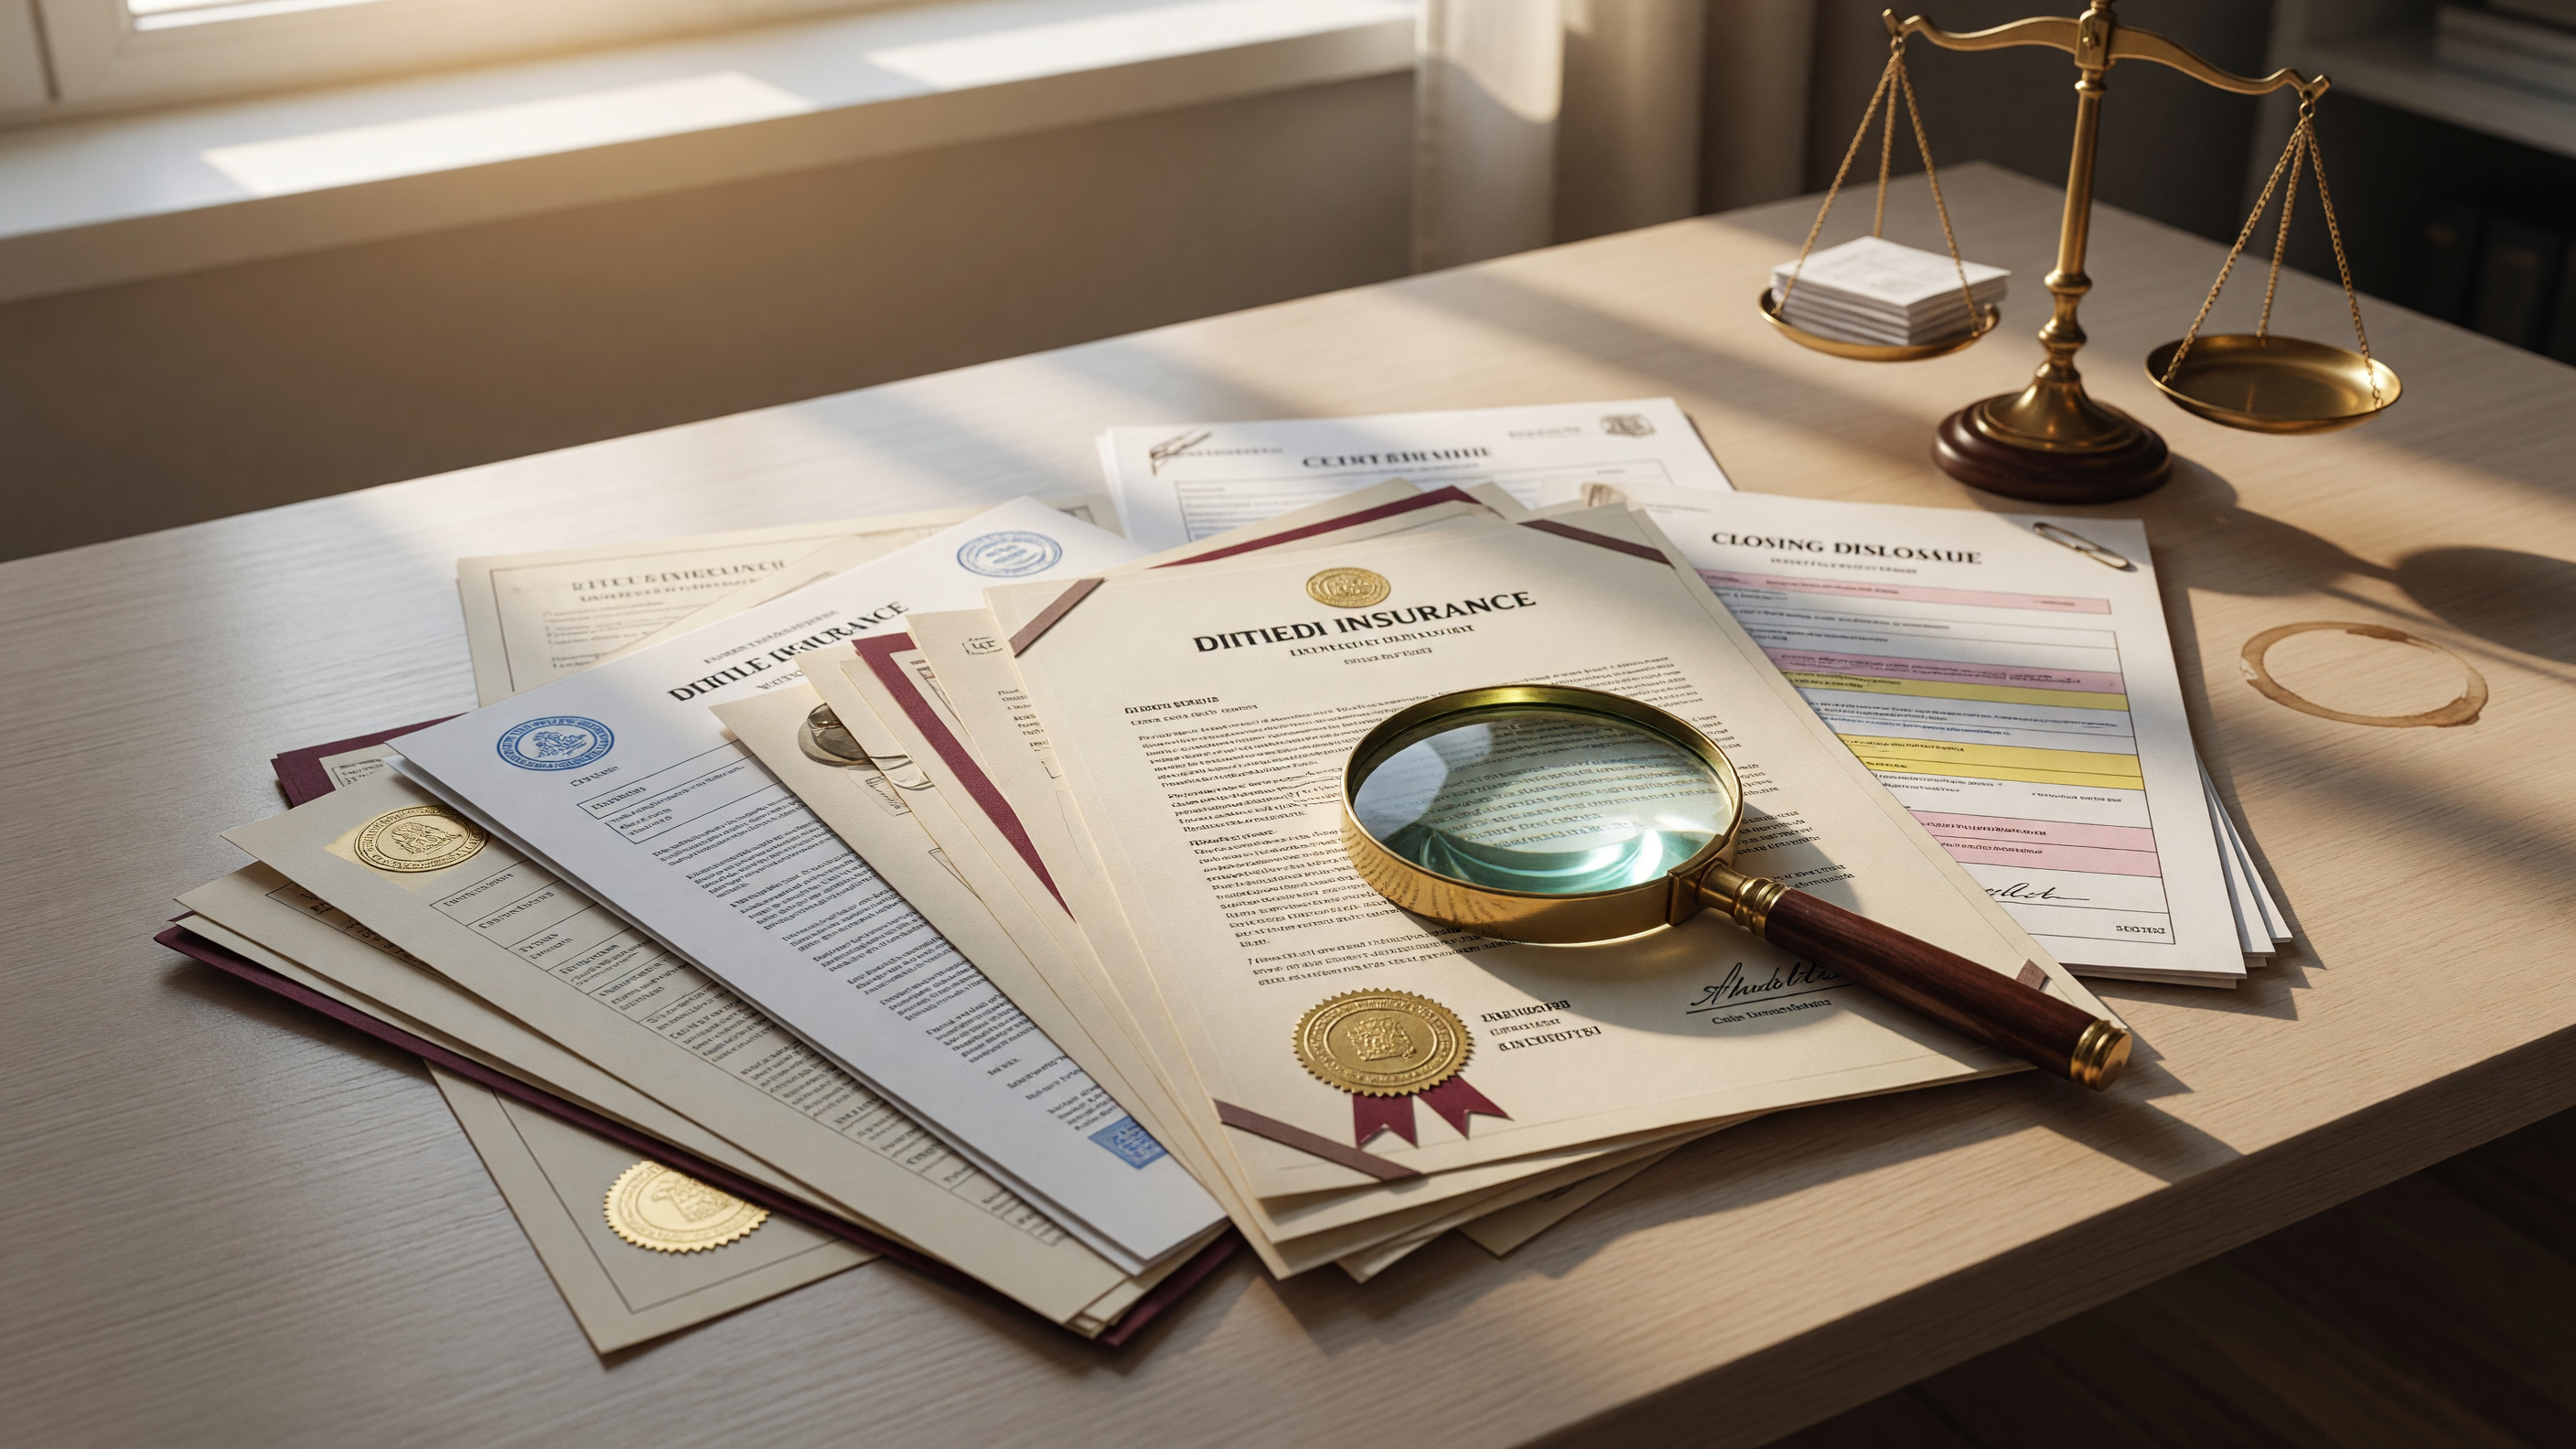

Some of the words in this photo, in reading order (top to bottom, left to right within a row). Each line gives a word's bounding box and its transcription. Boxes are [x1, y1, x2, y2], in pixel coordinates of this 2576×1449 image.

[1711, 531, 1824, 553] CLOSING
[1833, 542, 1982, 564] DISLOSSUE
[1333, 591, 1537, 634] INSURANCE
